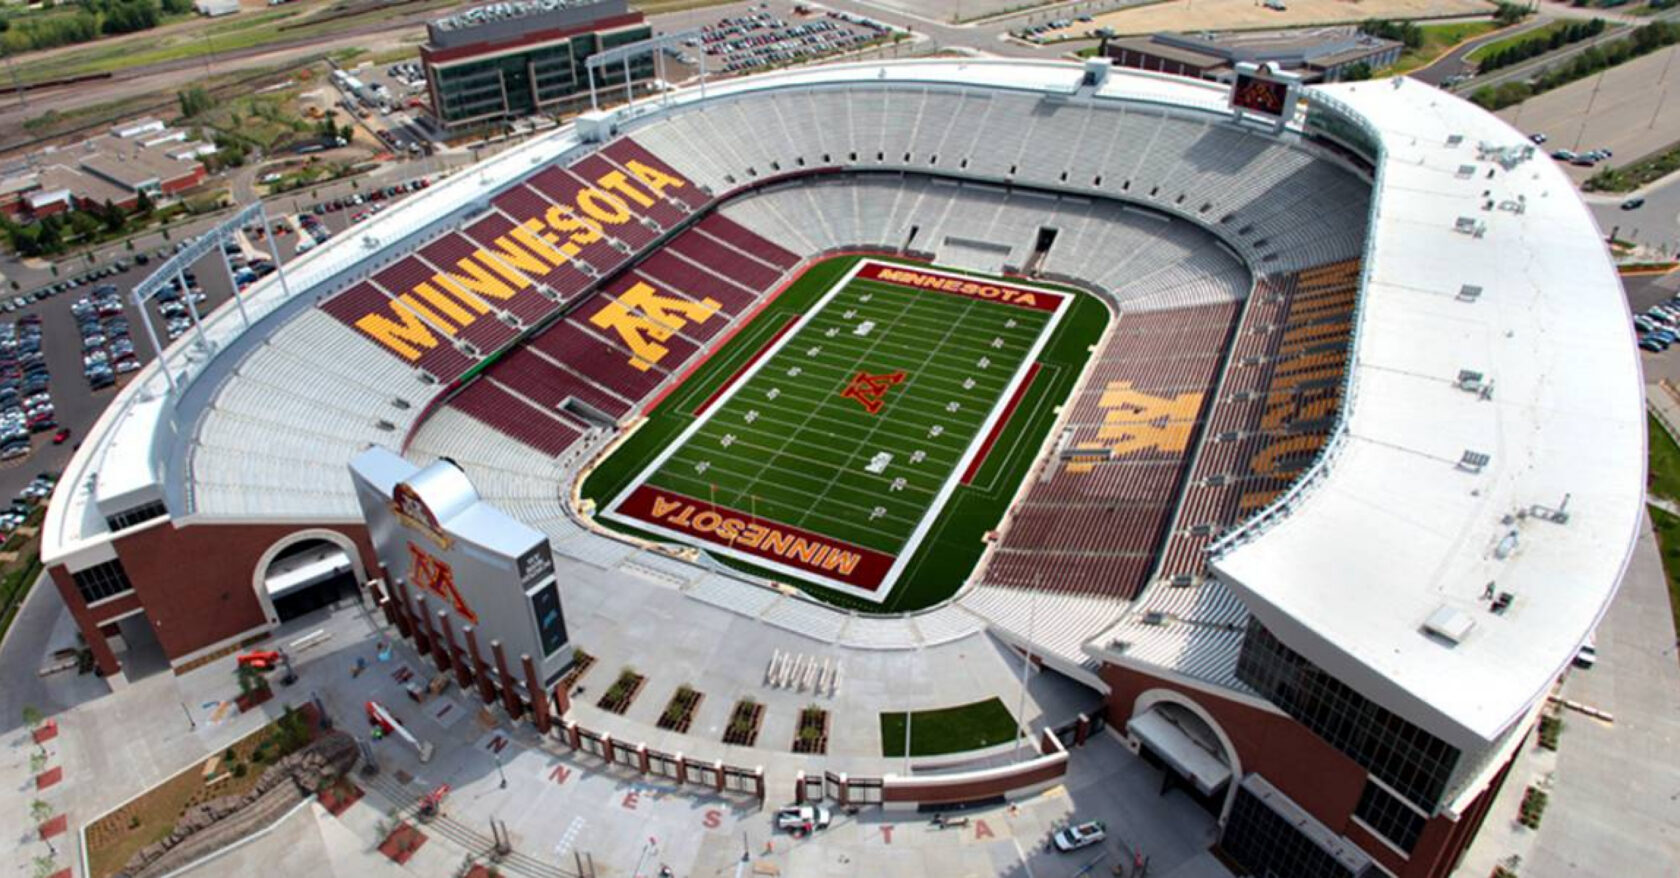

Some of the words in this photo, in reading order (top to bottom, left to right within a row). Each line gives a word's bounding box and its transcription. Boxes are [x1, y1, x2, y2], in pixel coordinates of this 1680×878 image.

[355, 159, 686, 361] MINNESOTA
[877, 267, 1037, 306] MINNESOTA
[588, 281, 724, 373] M
[841, 370, 907, 415] M
[650, 496, 861, 575] MINNESOTA
[407, 541, 479, 626] M
